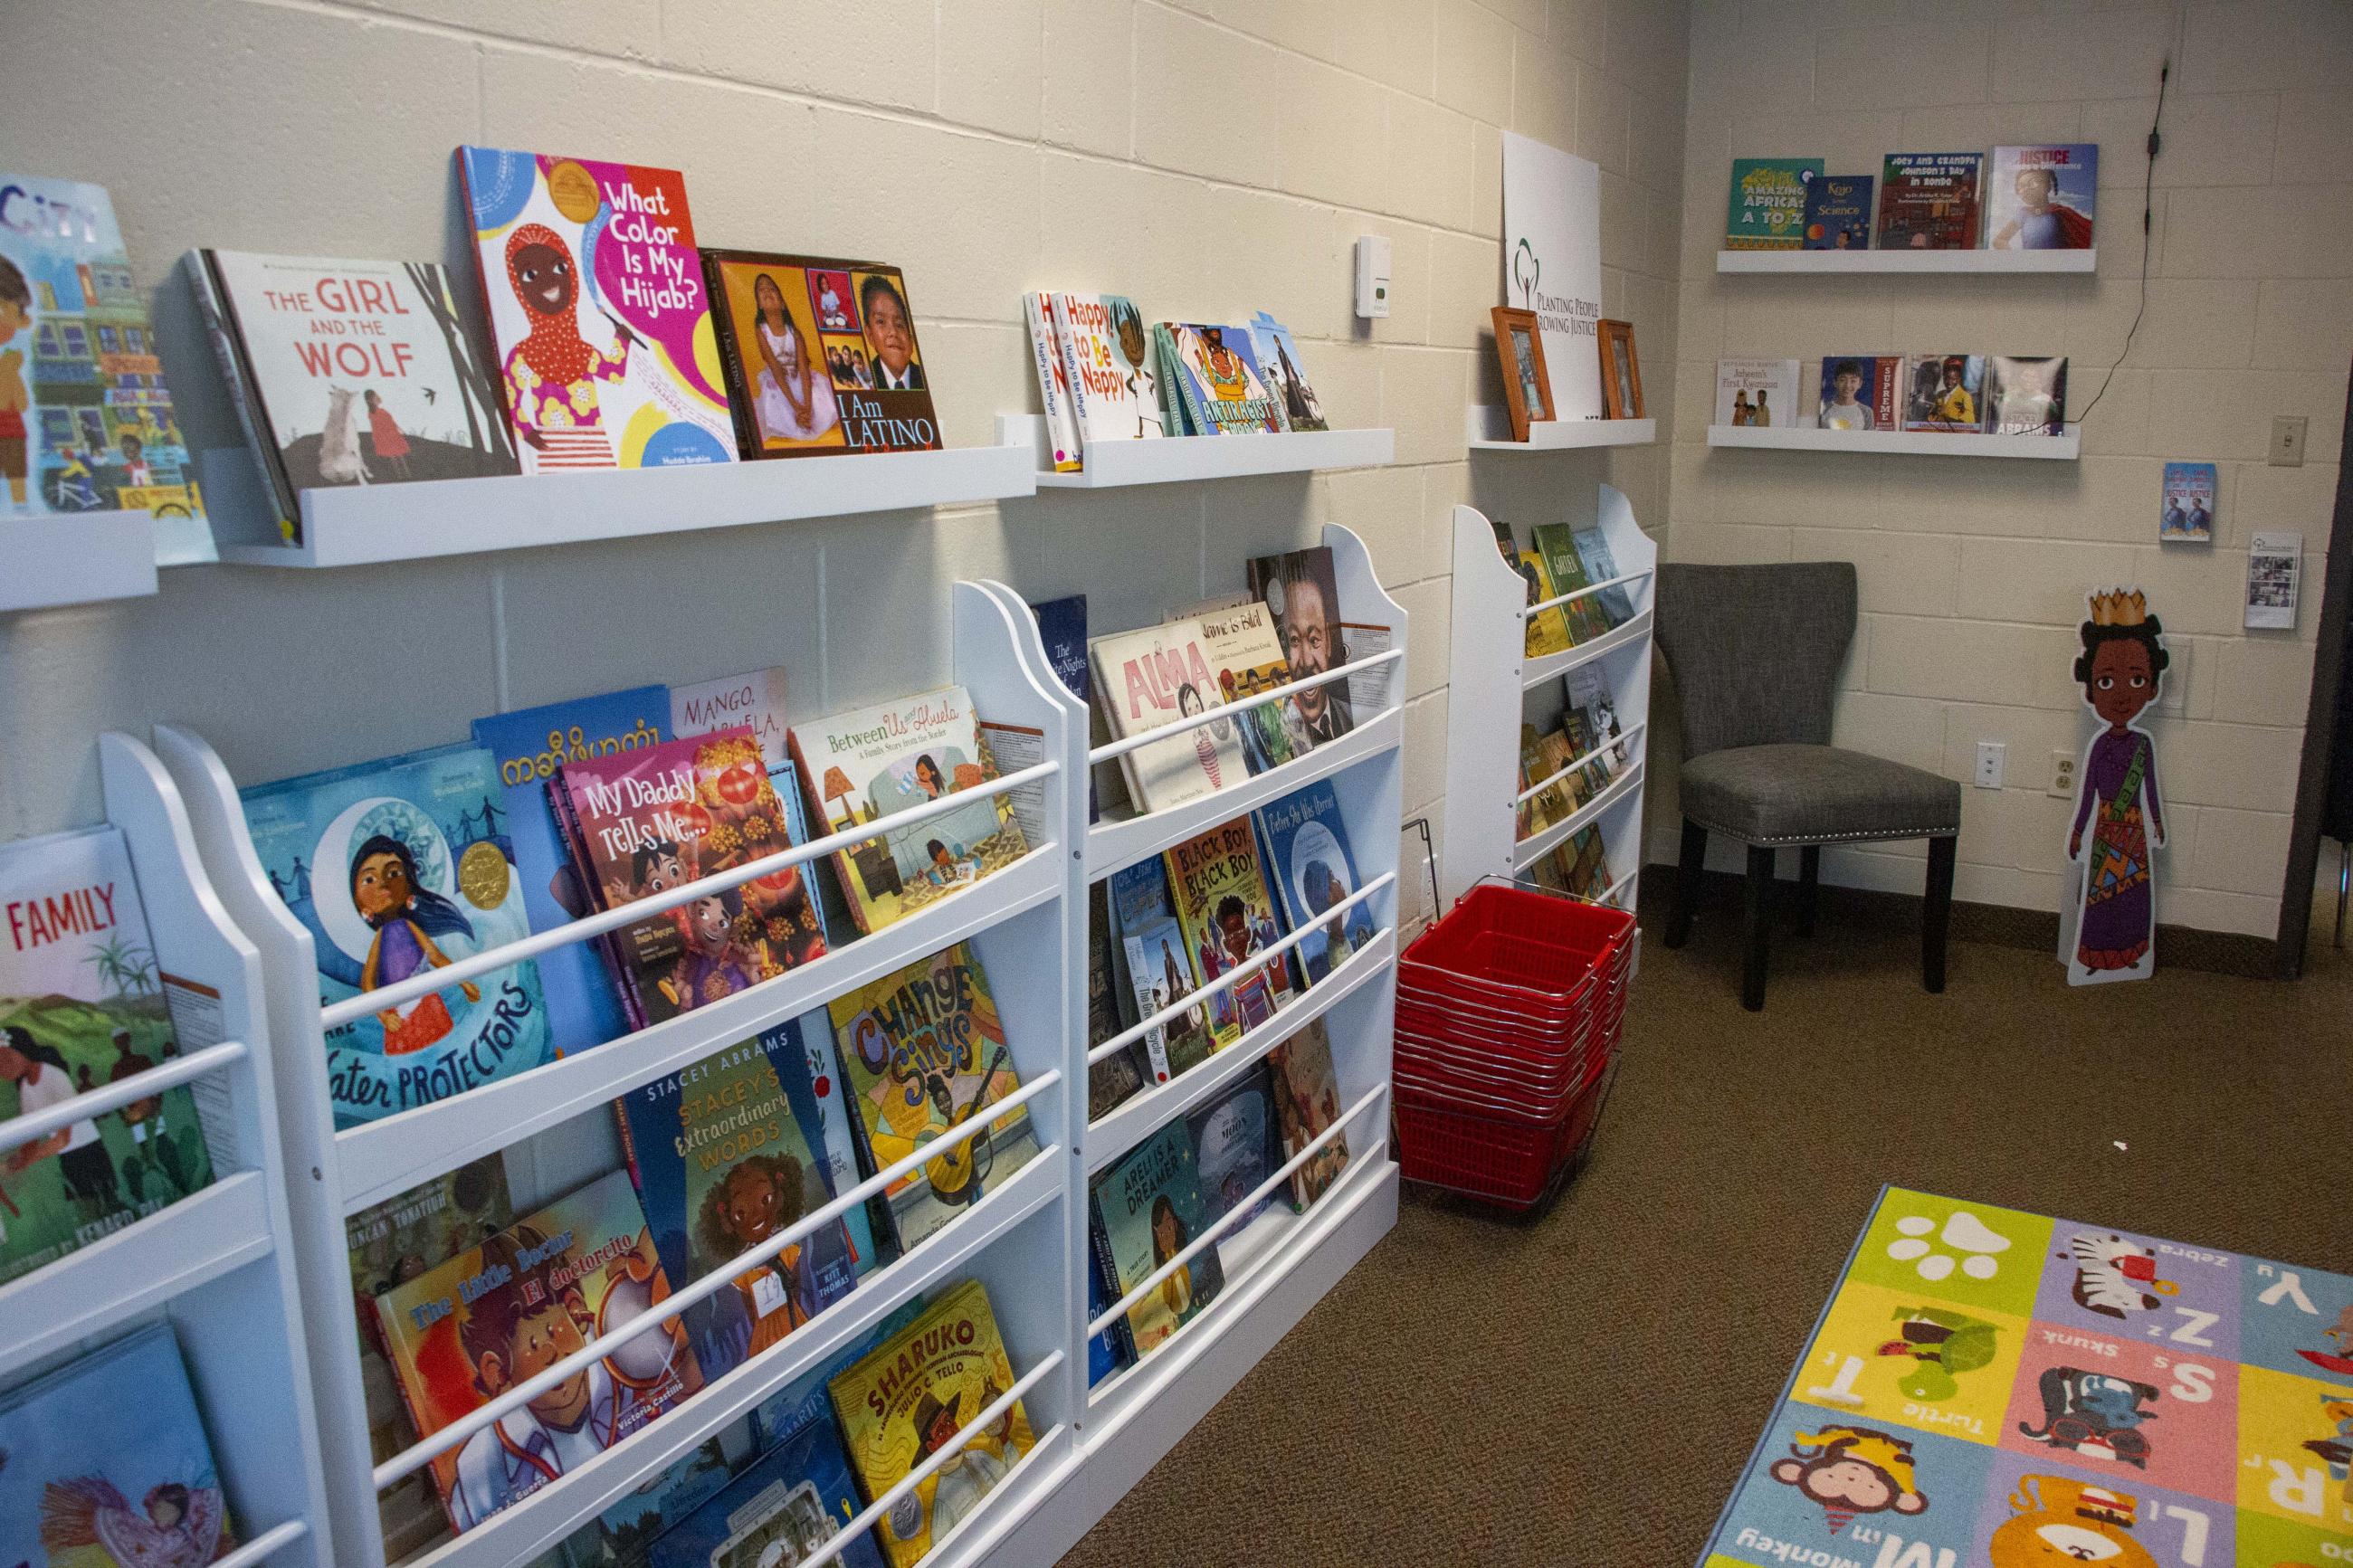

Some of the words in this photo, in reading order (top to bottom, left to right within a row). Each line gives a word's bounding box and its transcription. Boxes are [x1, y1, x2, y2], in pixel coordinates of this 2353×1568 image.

[1916, 157, 1934, 165] AND
[1949, 166, 1966, 176] DAY
[2020, 150, 2070, 165] JUSTICE
[604, 181, 670, 216] What
[1746, 186, 1805, 195] AMAZING
[1741, 211, 1754, 223] A
[1763, 212, 1785, 224] TO
[1792, 213, 1805, 224] Z
[1818, 204, 1861, 215] Science
[609, 213, 679, 246] Color
[623, 244, 643, 274] Is
[648, 246, 684, 286] My
[263, 290, 313, 312] THE
[316, 278, 410, 314] GIRL
[620, 277, 699, 318] Hijab?
[1537, 292, 1575, 315] PLANTING
[1575, 298, 1598, 318] PEOPLE
[310, 319, 346, 336] AND
[349, 319, 386, 337] THE
[1538, 315, 1569, 334] ROWING
[1570, 317, 1596, 337] JUSTICE
[294, 341, 414, 377] WOLF
[1065, 345, 1076, 371] Happy
[1073, 330, 1091, 359] to
[1091, 335, 1112, 367] Be
[1080, 361, 1125, 402] Nappy
[1880, 366, 1891, 422] SUPREME
[836, 394, 848, 418] I
[853, 394, 883, 418] Am
[1201, 398, 1272, 423] ANTIRACIST
[843, 418, 934, 448] LATINO
[1996, 423, 2052, 436] ABRAMS
[1554, 555, 1578, 575] GARDEN
[1241, 608, 1262, 632] Bilal
[1055, 643, 1070, 659] The
[1062, 656, 1087, 676] Nights
[1123, 641, 1216, 720] ALMA
[684, 685, 756, 727] MANGO,
[827, 727, 889, 753] Between
[883, 712, 909, 736] Us
[913, 700, 959, 730] Abuela
[864, 746, 884, 758] Family
[884, 740, 902, 752] Story
[902, 737, 919, 747] from
[918, 735, 928, 744] the
[928, 728, 948, 740] Border
[585, 781, 622, 820] My
[624, 769, 696, 809] Daddy
[1177, 836, 1222, 872] BLACK
[1185, 860, 1229, 899] BLACK
[1228, 848, 1253, 879] BOY
[6, 882, 116, 951] FAMILY
[1139, 988, 1149, 1003] The
[328, 1050, 393, 1108] ater
[397, 980, 533, 1107] PROTECTORS
[647, 1063, 709, 1102] STACEY
[720, 1032, 788, 1071] ABRAMS
[674, 1091, 791, 1158] Extraordinary
[698, 1119, 782, 1173] WORDS
[1124, 1157, 1152, 1195] ARELI
[1152, 1144, 1167, 1172] IS
[1166, 1138, 1176, 1153] A
[1126, 1156, 1180, 1216] DREAMER
[521, 1278, 547, 1307] El
[549, 1233, 633, 1290] doctorcito
[2159, 1244, 2229, 1268] Zebra
[410, 1296, 452, 1331] The
[458, 1264, 513, 1306] Little
[515, 1230, 573, 1273] Doctor
[818, 1275, 850, 1297] THOMAS
[824, 1268, 841, 1284] KITT
[2257, 1271, 2319, 1315] Y
[2043, 1330, 2119, 1358] Skunk
[2170, 1307, 2219, 1347] Z
[868, 1319, 975, 1418] SHARUKO
[1807, 1356, 1864, 1404] T
[2170, 1363, 2217, 1402] S
[616, 1404, 653, 1430] Victoria
[653, 1383, 685, 1407] Castillo
[898, 1385, 922, 1418] JULIO
[924, 1376, 934, 1388] C.
[936, 1361, 964, 1381] TELLO
[1902, 1402, 1985, 1435] Turtle
[2268, 1459, 2326, 1517] R
[1736, 1527, 1861, 1568] Monkey
[2166, 1505, 2210, 1567] L
